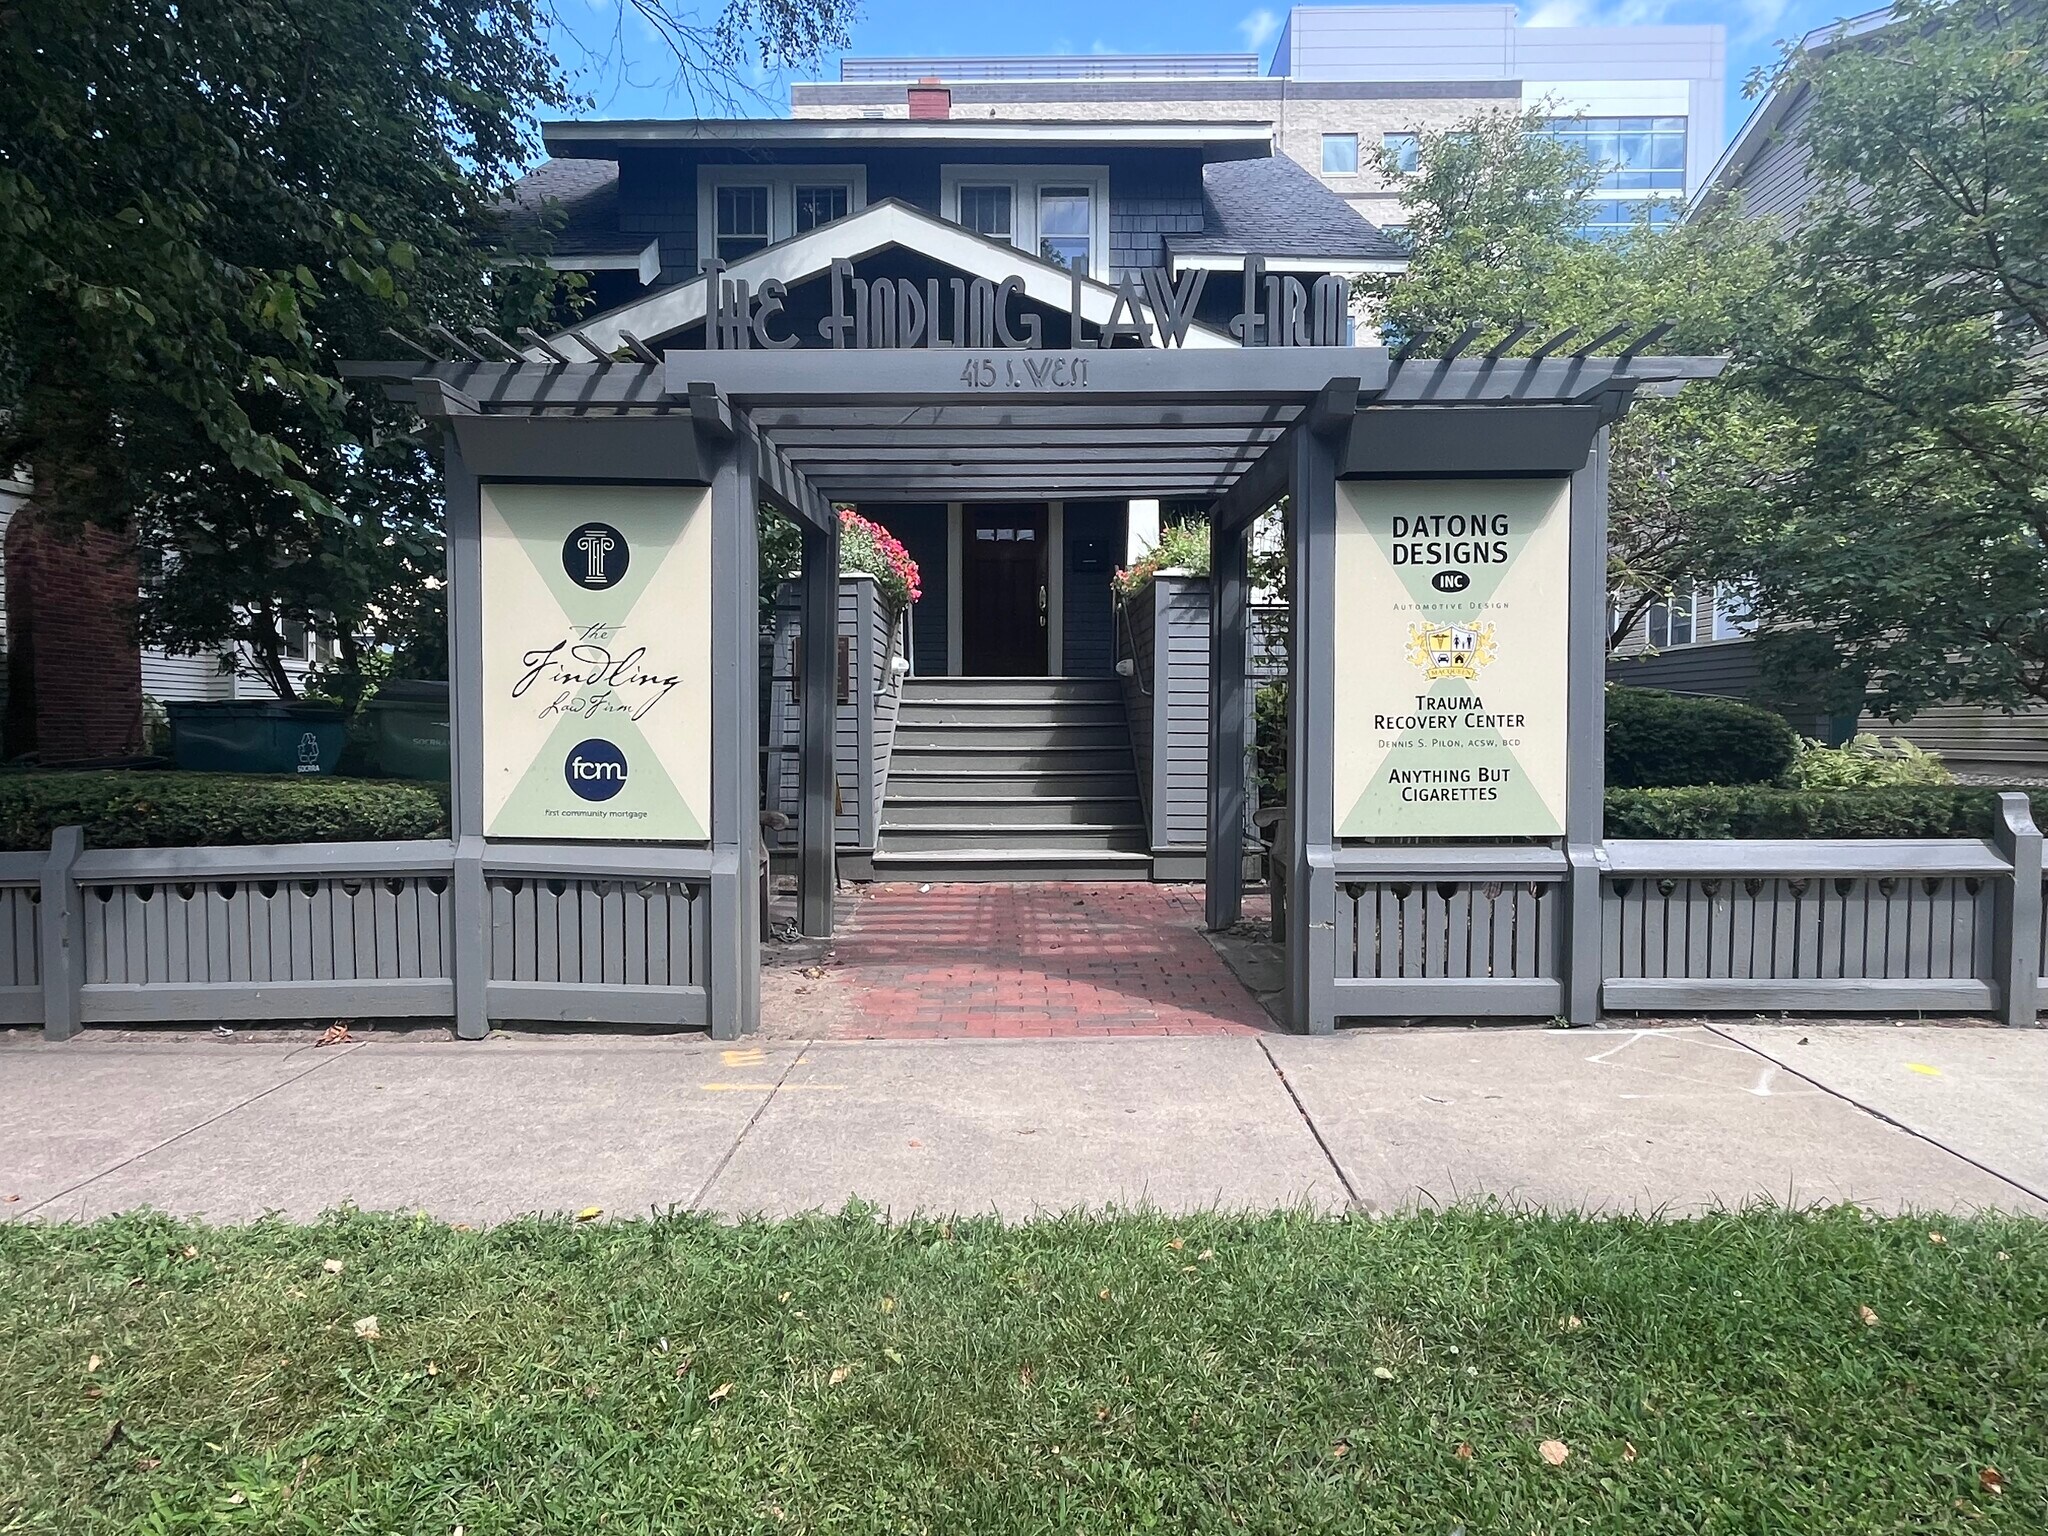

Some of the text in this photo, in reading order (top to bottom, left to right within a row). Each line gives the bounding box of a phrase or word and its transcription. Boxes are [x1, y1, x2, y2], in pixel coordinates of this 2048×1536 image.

[817, 257, 1041, 350] FINDLING
[1070, 255, 1208, 350] LAW
[1229, 253, 1349, 347] FIRM
[960, 357, 1090, 388] 415 S. WEST
[1392, 514, 1509, 538] DATONG
[1392, 541, 1508, 565] DESIGNS
[1439, 575, 1463, 588] INC
[569, 622, 627, 641] The
[512, 639, 683, 722] Findling
[538, 690, 633, 719] Law Firm
[1417, 738, 1428, 748] S.
[572, 755, 628, 781] fcm
[544, 808, 648, 820] first community mortgage
